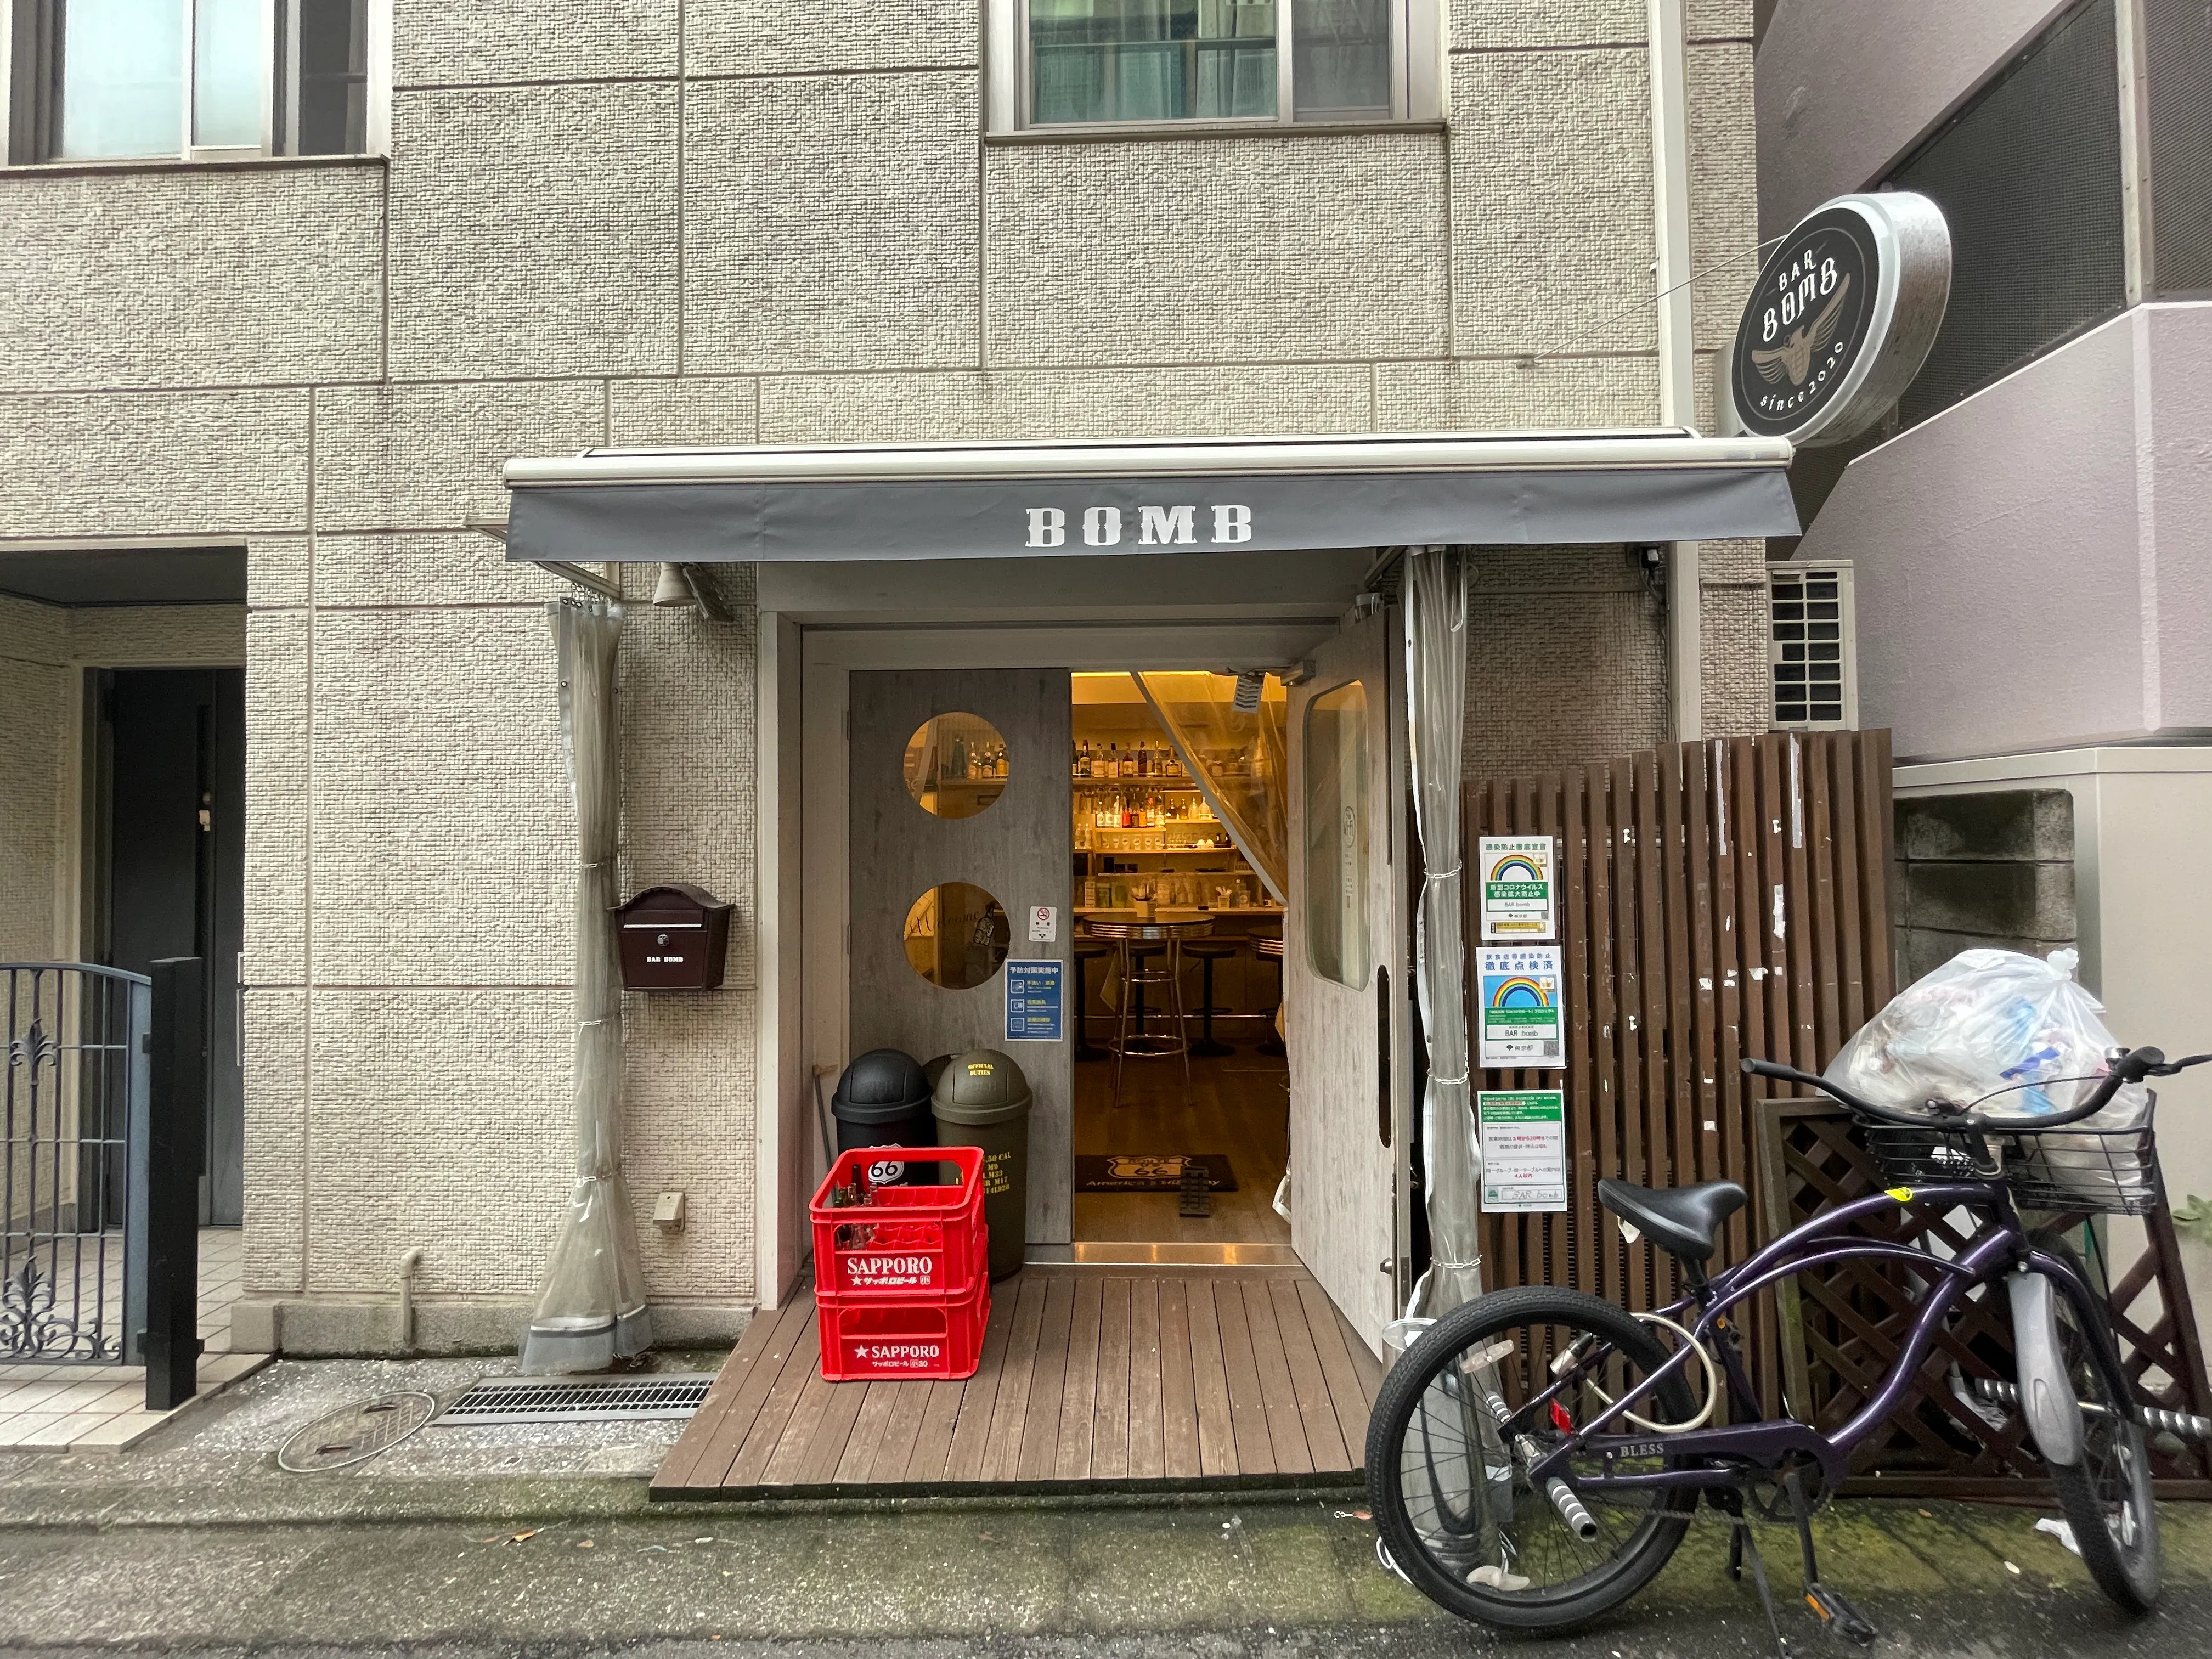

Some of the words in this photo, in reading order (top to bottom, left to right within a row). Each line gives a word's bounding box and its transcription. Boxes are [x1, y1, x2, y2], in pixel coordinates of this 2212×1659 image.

[1778, 249, 1817, 291] BAR
[1762, 257, 1838, 342] BOMB
[1025, 504, 1251, 548] BOMB
[1485, 960, 1554, 971] 徹底点検済
[871, 1161, 898, 1177] 66
[1134, 1167, 1168, 1176] 66
[1512, 1190, 1532, 1200] BAR
[847, 1256, 933, 1274] SAPPORO
[863, 1276, 917, 1285] サッポロビール
[871, 1345, 939, 1358] SAPPORO
[1620, 1443, 1664, 1457] BLESS
